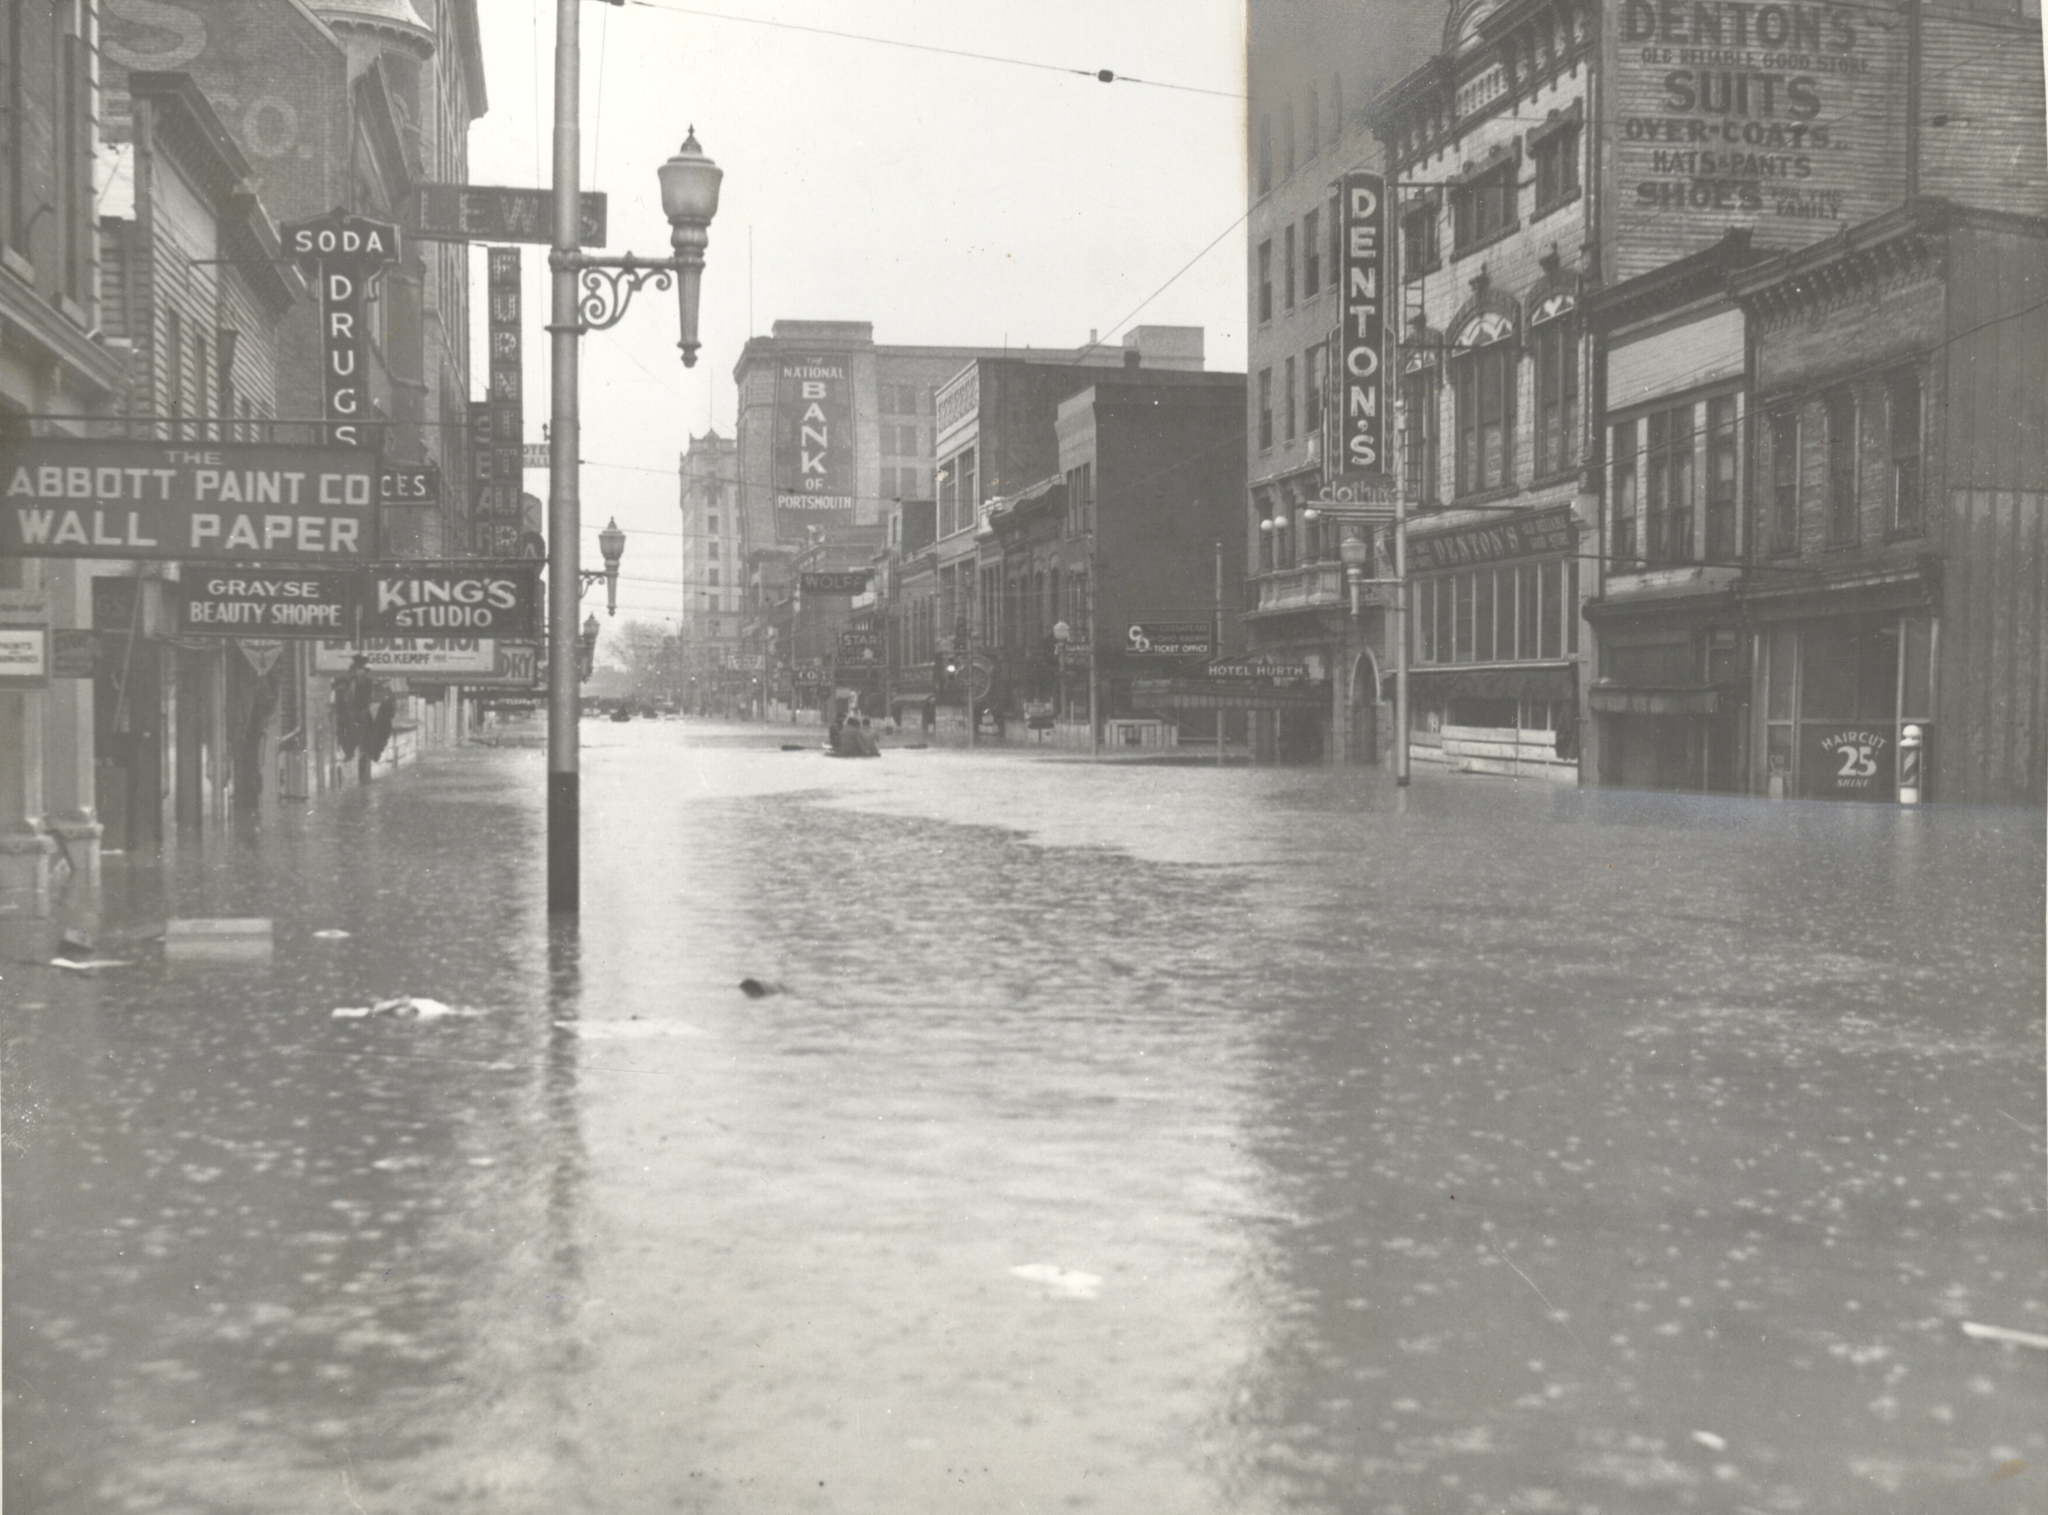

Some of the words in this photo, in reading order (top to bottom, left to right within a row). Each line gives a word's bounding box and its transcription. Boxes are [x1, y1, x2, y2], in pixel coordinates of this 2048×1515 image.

[1680, 48, 1754, 67] RELIABLE
[1762, 52, 1810, 69] GOOD
[1818, 55, 1869, 72] STORE
[1664, 70, 1821, 119] SUITS
[1625, 117, 1830, 149] OVER-COATS
[1653, 151, 1716, 174] HATS
[1731, 153, 1811, 178] PANTS
[1636, 181, 1762, 209] SHOES
[421, 189, 598, 238] LEWS
[1777, 200, 1841, 219] FAMILY
[295, 230, 383, 253] SODA
[330, 274, 357, 446] DRUGS
[783, 366, 845, 380] NATIONAL
[492, 254, 517, 553] FURNITUR
[801, 381, 828, 474] BANK
[164, 450, 223, 465] THE
[6, 466, 177, 500] ABBOTT
[195, 469, 306, 505] PAINT
[318, 473, 371, 505] CO
[805, 478, 824, 491] OF
[777, 495, 851, 509] PORTSMOUTH
[16, 509, 158, 547] WALL
[190, 513, 359, 553] PAPER
[1433, 526, 1520, 561] DENTON'S
[207, 579, 320, 598] GRAYSE
[378, 578, 516, 613] KING'S
[190, 601, 266, 624] BEAUTY
[271, 603, 342, 626] SHOPPE
[396, 605, 492, 627] STUDIO
[843, 634, 877, 645] STAR
[1153, 644, 1179, 653] TICKET
[1182, 644, 1208, 653] OFFICE
[394, 653, 430, 664] KEMPF
[1208, 664, 1251, 676] HOTEL
[1256, 666, 1303, 676] HURTH
[1821, 731, 1887, 751] HAIRCUT
[1837, 745, 1877, 776] 25
